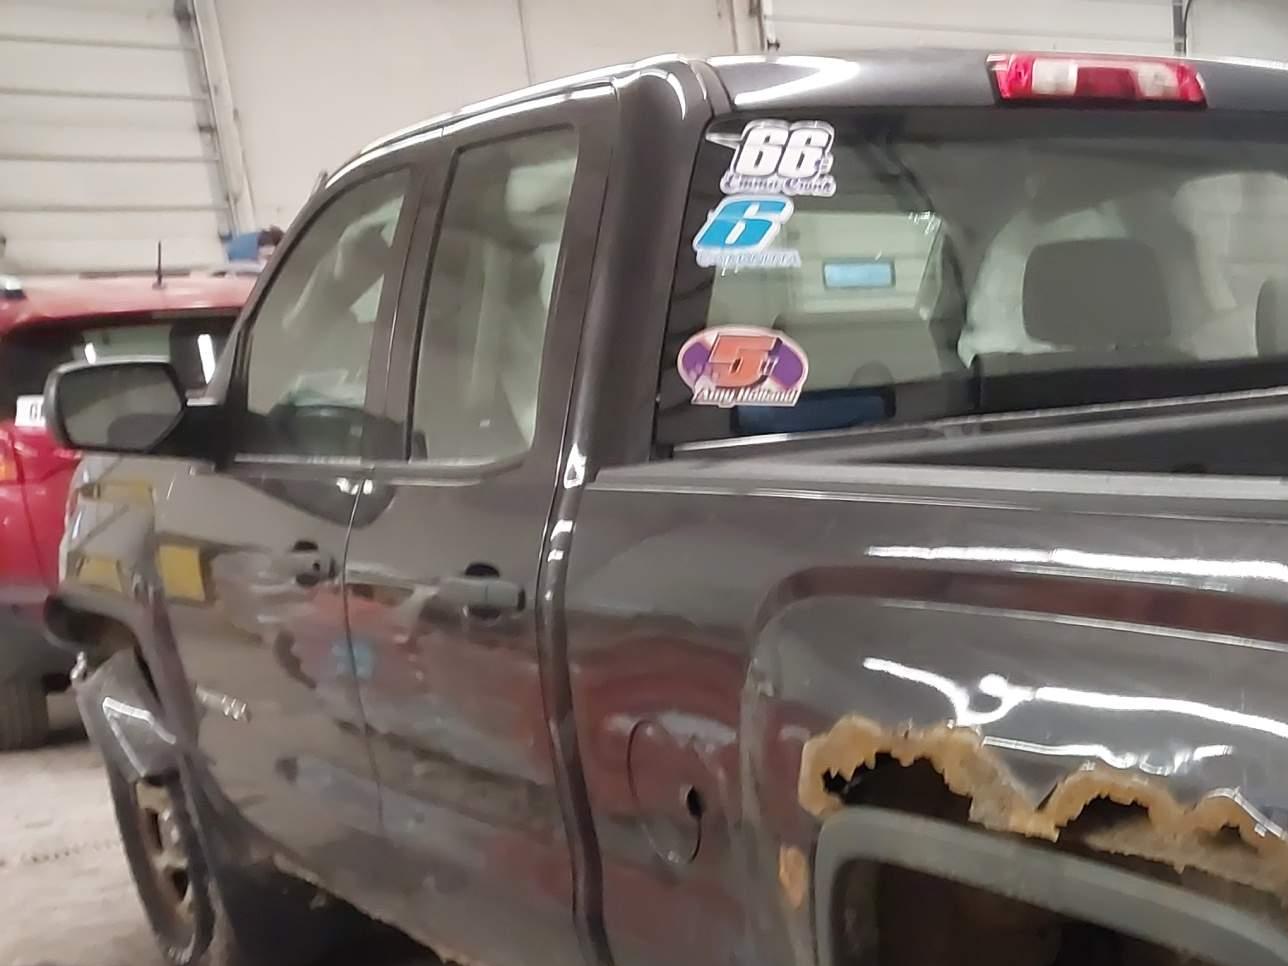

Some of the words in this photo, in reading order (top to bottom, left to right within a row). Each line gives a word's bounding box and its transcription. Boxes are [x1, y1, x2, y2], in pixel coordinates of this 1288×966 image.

[734, 121, 833, 178] 66
[696, 197, 790, 249] 6
[708, 334, 782, 387] 5
